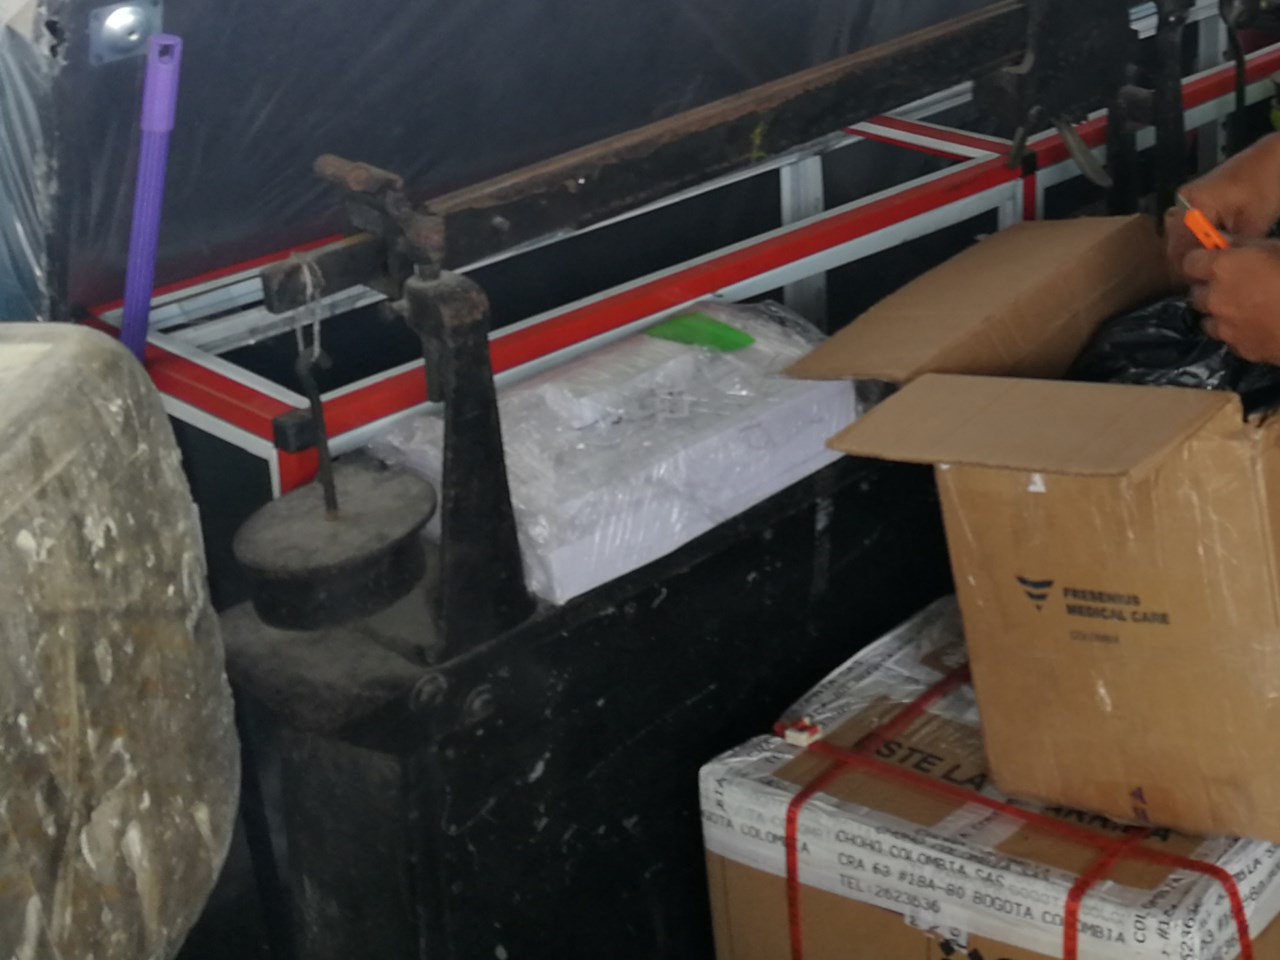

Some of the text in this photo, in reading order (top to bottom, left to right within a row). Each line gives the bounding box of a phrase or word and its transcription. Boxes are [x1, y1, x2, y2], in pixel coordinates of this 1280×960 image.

[1065, 603, 1170, 625] MEDICAL CARE
[874, 741, 944, 774] STE
[941, 762, 990, 792] LA
[835, 829, 884, 855] CHOHO
[888, 844, 969, 879] COLOMBIA
[974, 867, 1006, 889] SAS
[837, 852, 866, 872] CRA
[971, 889, 1034, 921] BOGOTA
[1040, 910, 1128, 945] COOMBIA
